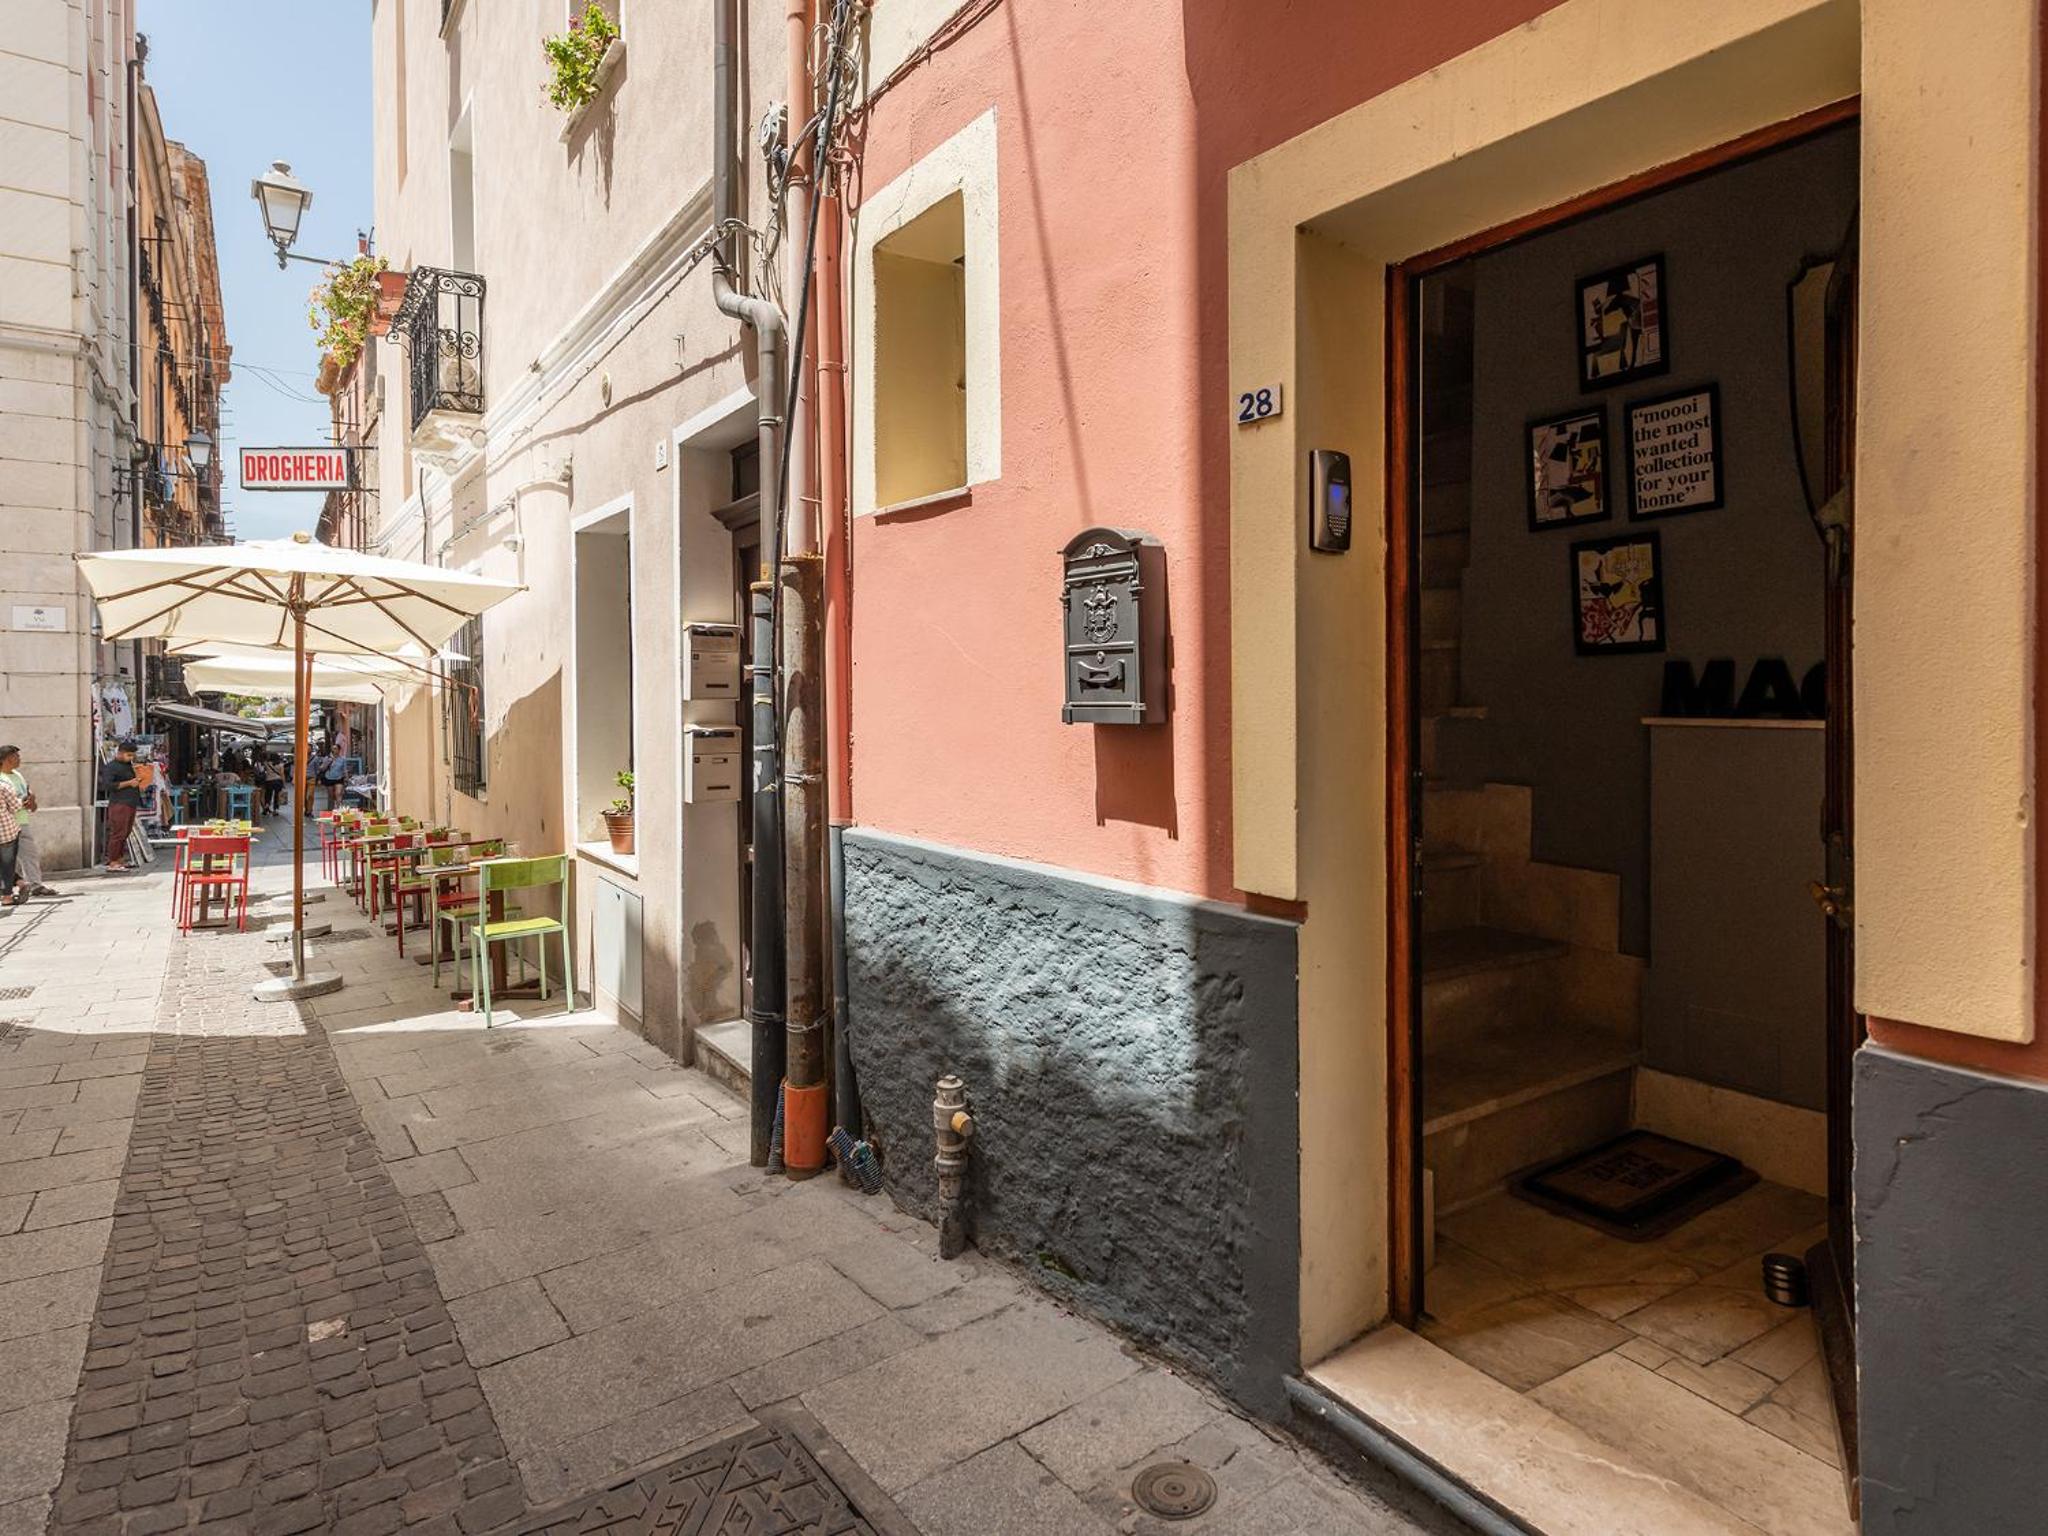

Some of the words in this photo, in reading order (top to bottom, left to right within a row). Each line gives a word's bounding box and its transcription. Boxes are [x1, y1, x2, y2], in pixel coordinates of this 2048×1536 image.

[1239, 388, 1272, 421] 28
[1635, 426, 1661, 442] the
[1666, 415, 1710, 436] most
[1635, 433, 1699, 458] wanted
[244, 455, 345, 481] DROGHERIA
[1636, 451, 1714, 476] collection
[1637, 476, 1662, 492] for
[1667, 469, 1710, 491] your
